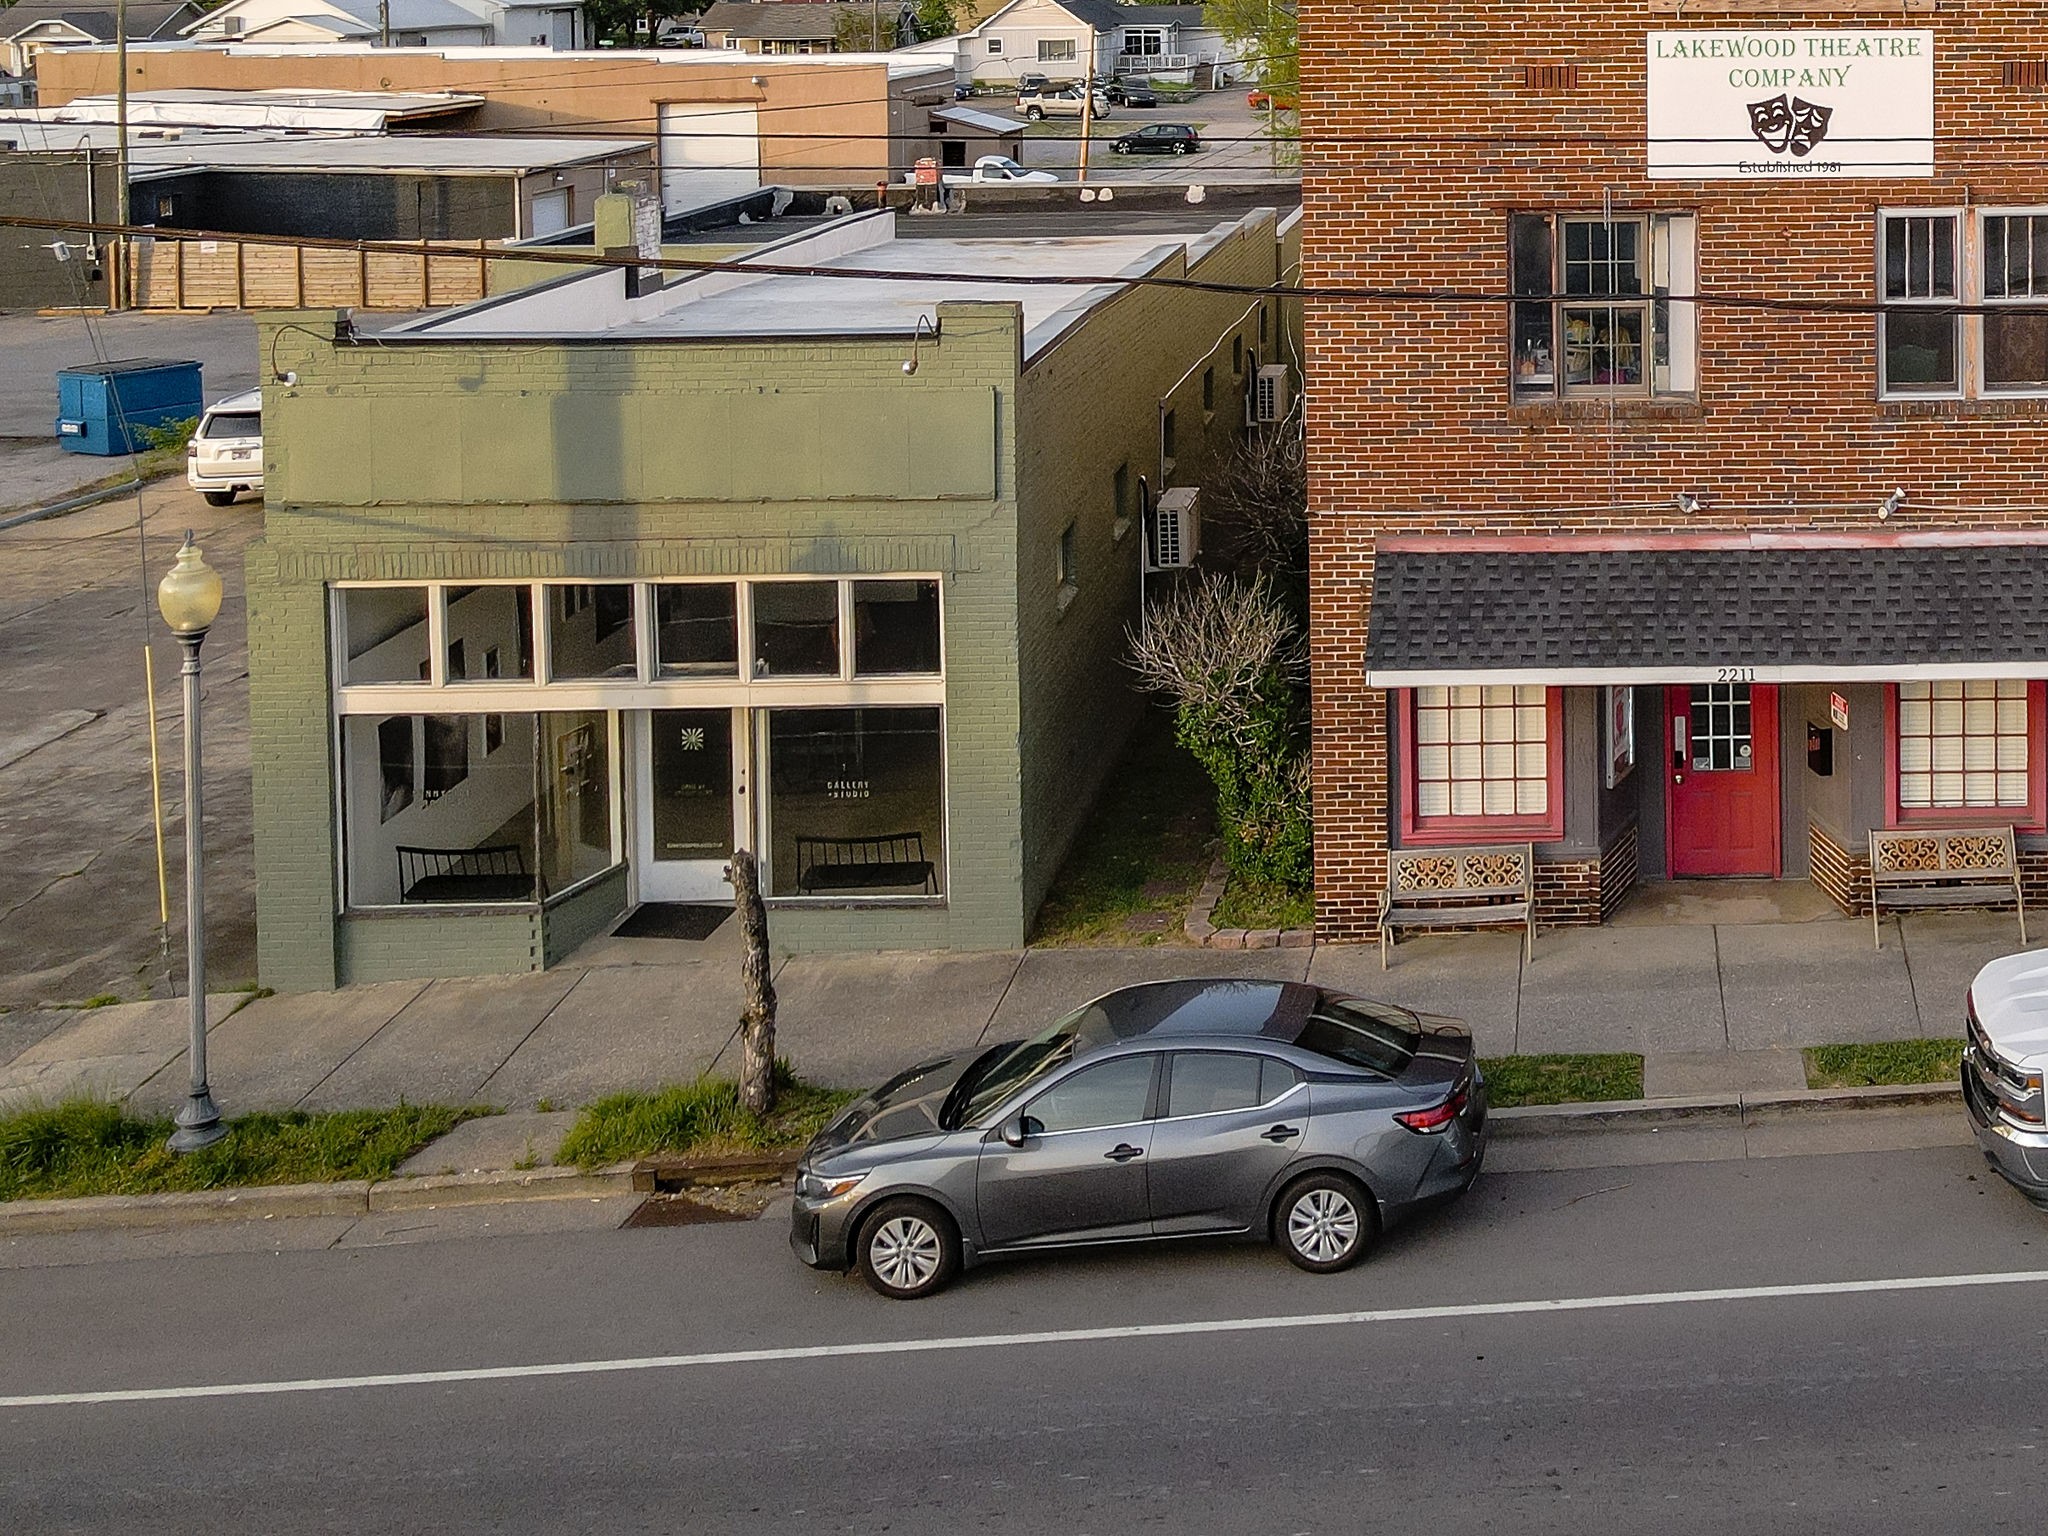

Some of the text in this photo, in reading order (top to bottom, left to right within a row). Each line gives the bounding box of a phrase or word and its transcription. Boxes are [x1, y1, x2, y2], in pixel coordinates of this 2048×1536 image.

[1656, 35, 1922, 58] LAKEWOOD THEATRE
[1728, 64, 1852, 88] COMPANY
[1739, 160, 1841, 173] Established 1981
[1718, 668, 1756, 682] 2211
[827, 780, 869, 790] GALLERY
